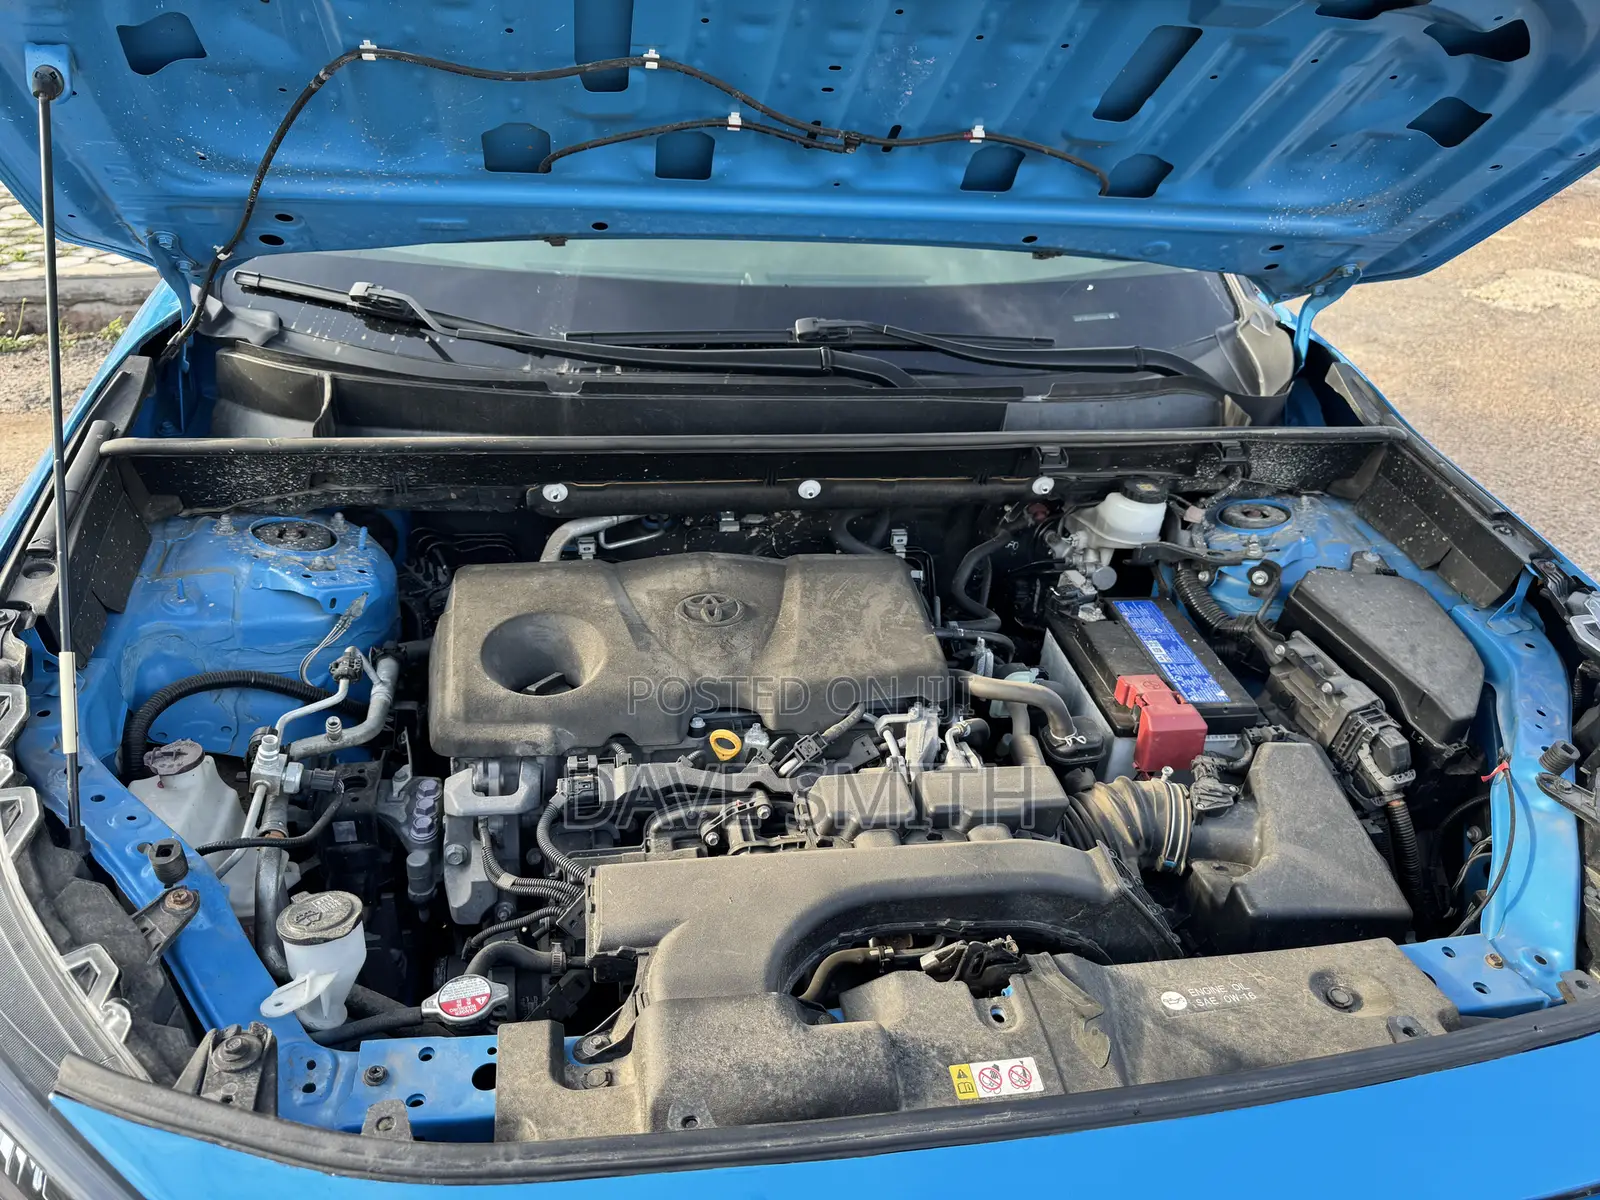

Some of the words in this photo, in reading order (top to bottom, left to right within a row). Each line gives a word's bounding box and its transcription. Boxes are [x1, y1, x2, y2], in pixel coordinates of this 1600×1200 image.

[1188, 985, 1228, 997] ENGINE
[1231, 982, 1251, 991] OIL
[1196, 997, 1220, 1008] SAE
